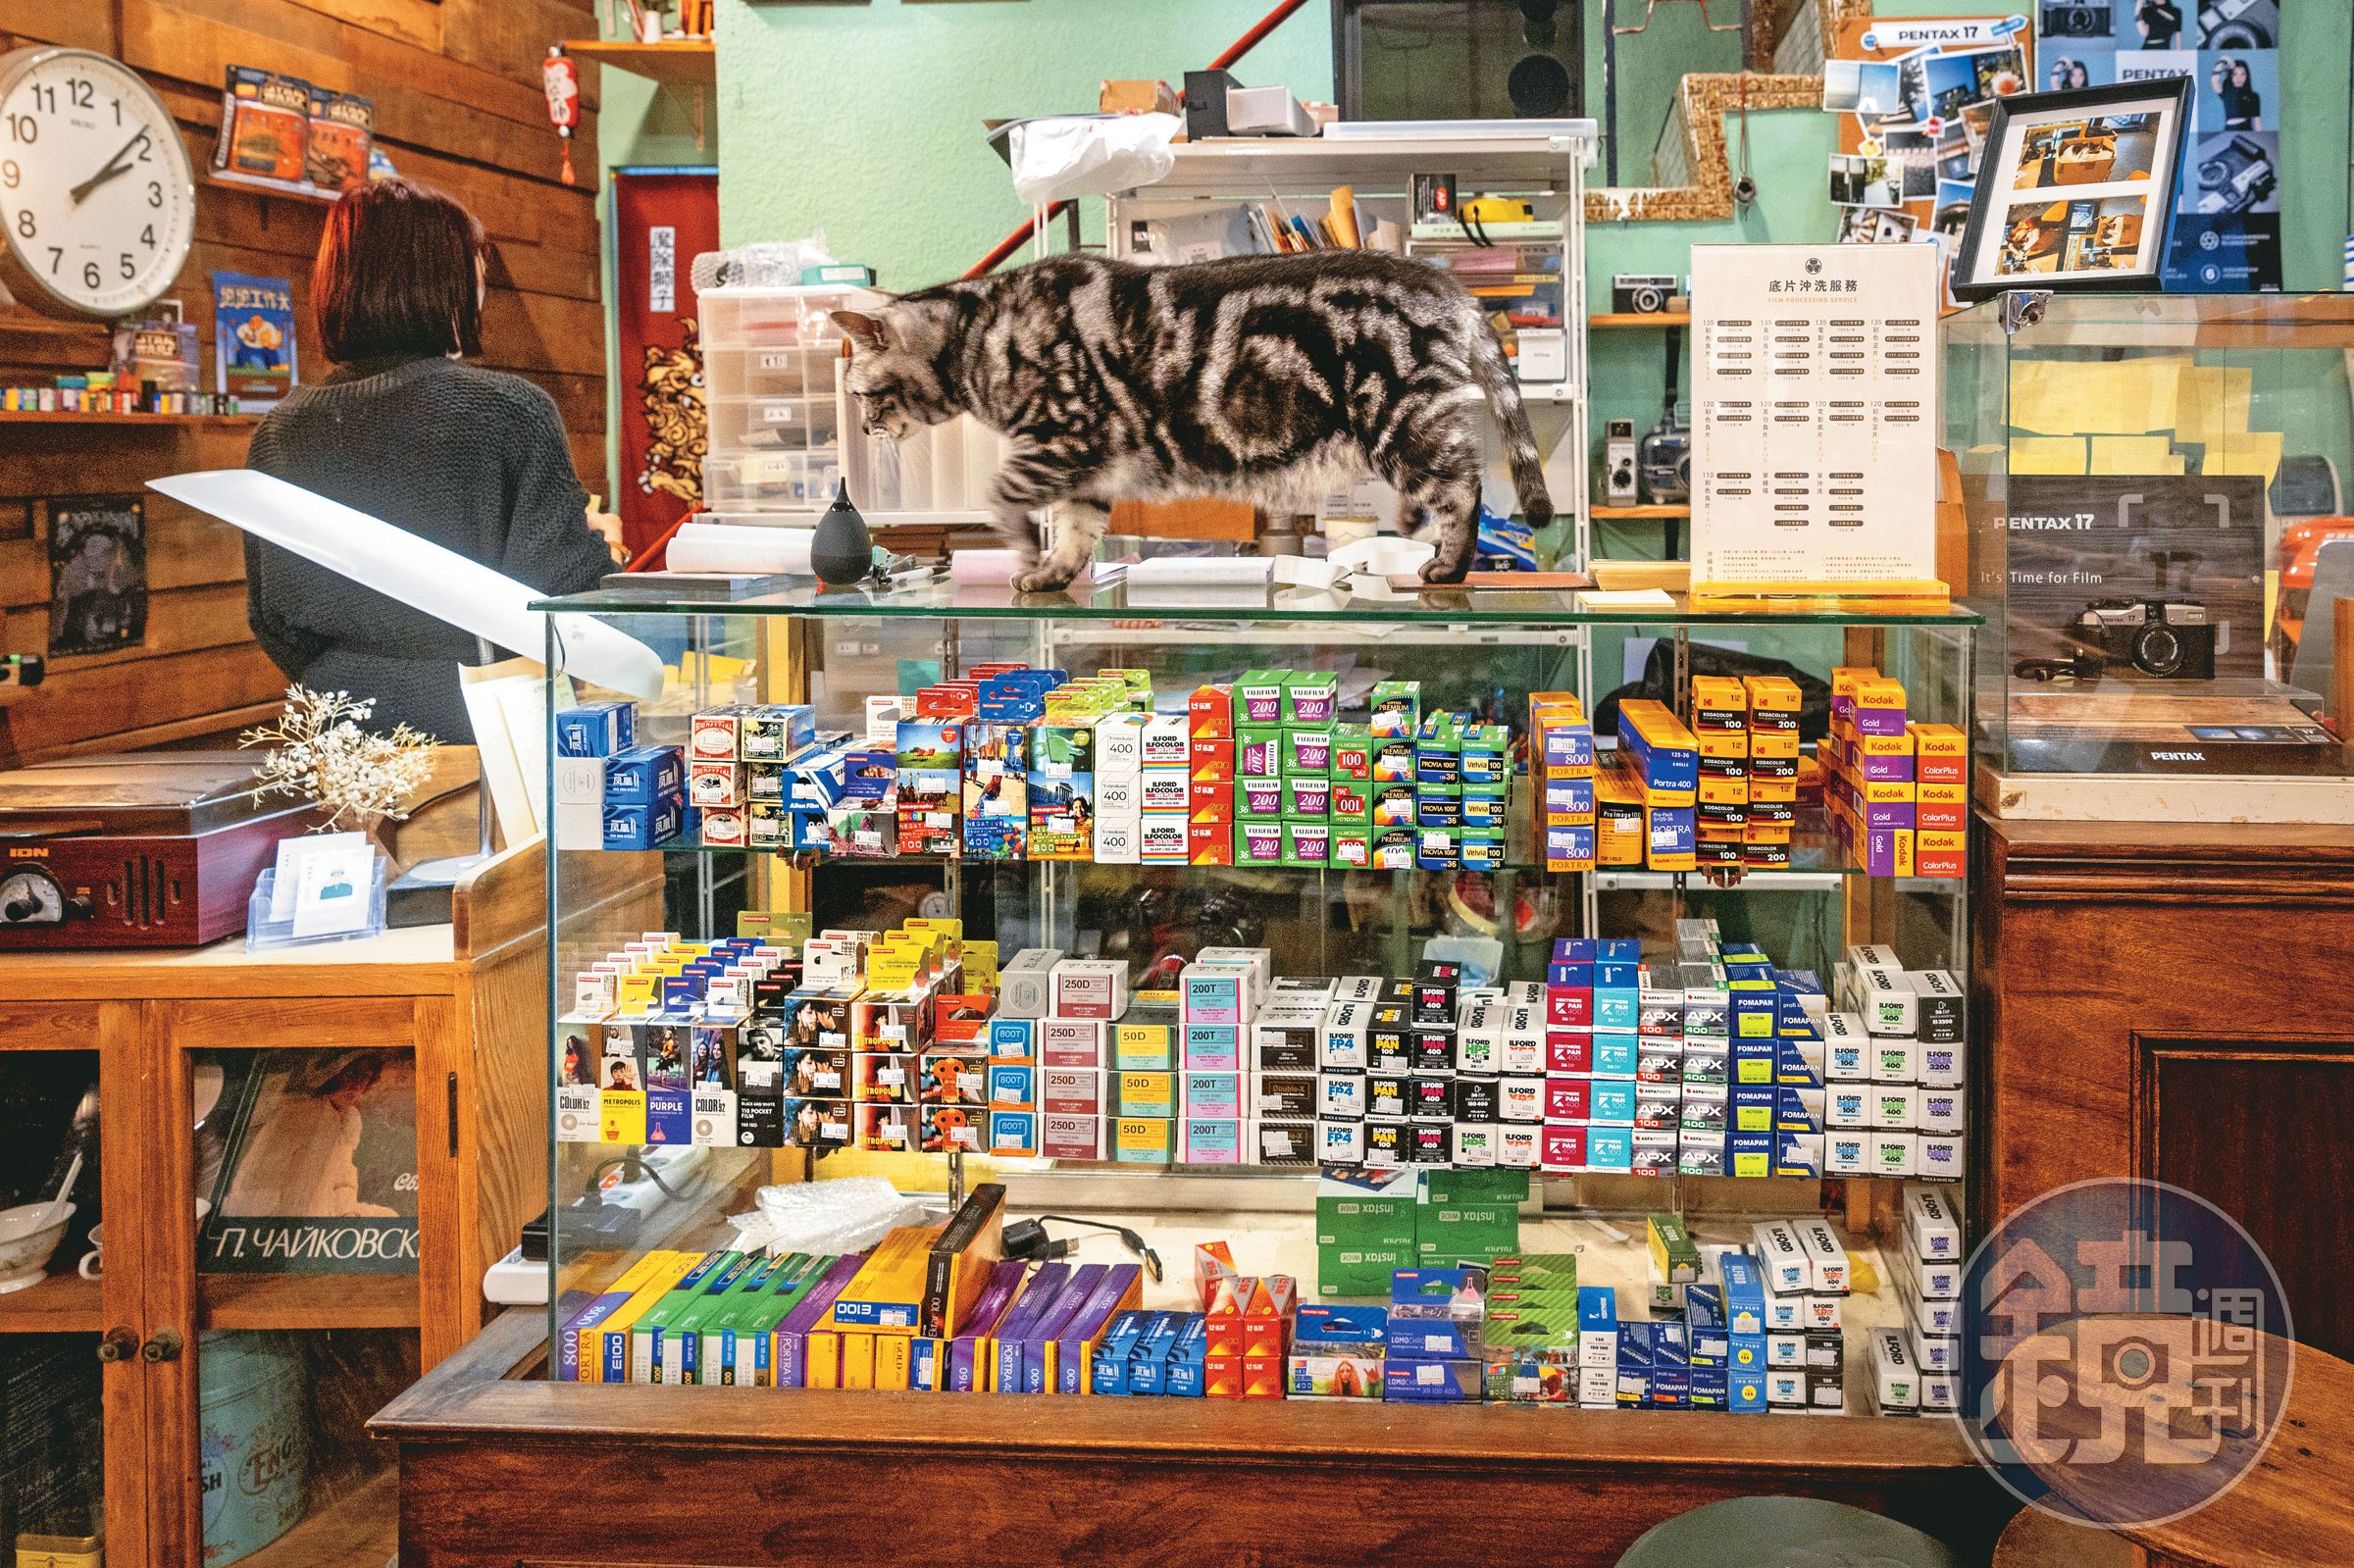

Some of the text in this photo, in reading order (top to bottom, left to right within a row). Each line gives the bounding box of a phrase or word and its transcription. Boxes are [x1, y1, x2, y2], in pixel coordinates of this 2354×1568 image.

[1899, 25, 1978, 41] PENTAX 17
[2123, 69, 2188, 79] PENTAX
[31, 83, 55, 114] 11
[66, 77, 94, 109] 12
[111, 99, 121, 126] 1
[6, 113, 37, 144] 10
[137, 134, 152, 162] 2
[2, 160, 21, 188] 9
[148, 181, 163, 207] 3
[19, 210, 35, 238] 8
[140, 224, 156, 249] 4
[48, 247, 63, 274] 7
[121, 254, 135, 279] 5
[84, 263, 100, 289] 6
[1768, 279, 1858, 292] 底片沖洗服務
[1993, 514, 2094, 530] PENTAX 17
[1981, 572, 2102, 583] It's Time for Film
[1864, 695, 1894, 704] Kodak
[1252, 701, 1276, 714] 200
[1299, 702, 1323, 714] 200
[1109, 743, 1133, 753] 400
[1870, 742, 1902, 751] Kodak
[1925, 742, 1956, 751] Kodak
[1301, 748, 1326, 761] 200
[1342, 753, 1361, 766] 100
[1565, 754, 1589, 764] 800
[2150, 752, 2205, 761] PENTAX
[1103, 791, 1126, 801] 400
[1873, 789, 1904, 798] Kodak
[1923, 789, 1954, 799] Kodak
[1253, 794, 1277, 806] 200
[1922, 813, 1957, 822] ColorPlus
[901, 839, 922, 849] 100
[9, 847, 49, 858] ION
[1064, 980, 1090, 988] 250D
[1192, 984, 1216, 993] 200T
[1422, 994, 1446, 1003] PAN
[1641, 1011, 1679, 1022] APX
[1686, 1011, 1723, 1022] APX
[1123, 1032, 1147, 1041] 50D
[1329, 1039, 1354, 1049] FP4
[1376, 1039, 1399, 1049] PAN
[1465, 1044, 1491, 1054] HP5
[650, 1102, 683, 1111] PURPLE
[253, 1226, 420, 1259] ЧАЙКОВСК
[1364, 1252, 1396, 1262] instax
[837, 1303, 872, 1315] E100
[929, 1297, 941, 1338] Ektar 100
[563, 1332, 577, 1365] 800
[612, 1335, 622, 1370] E100
